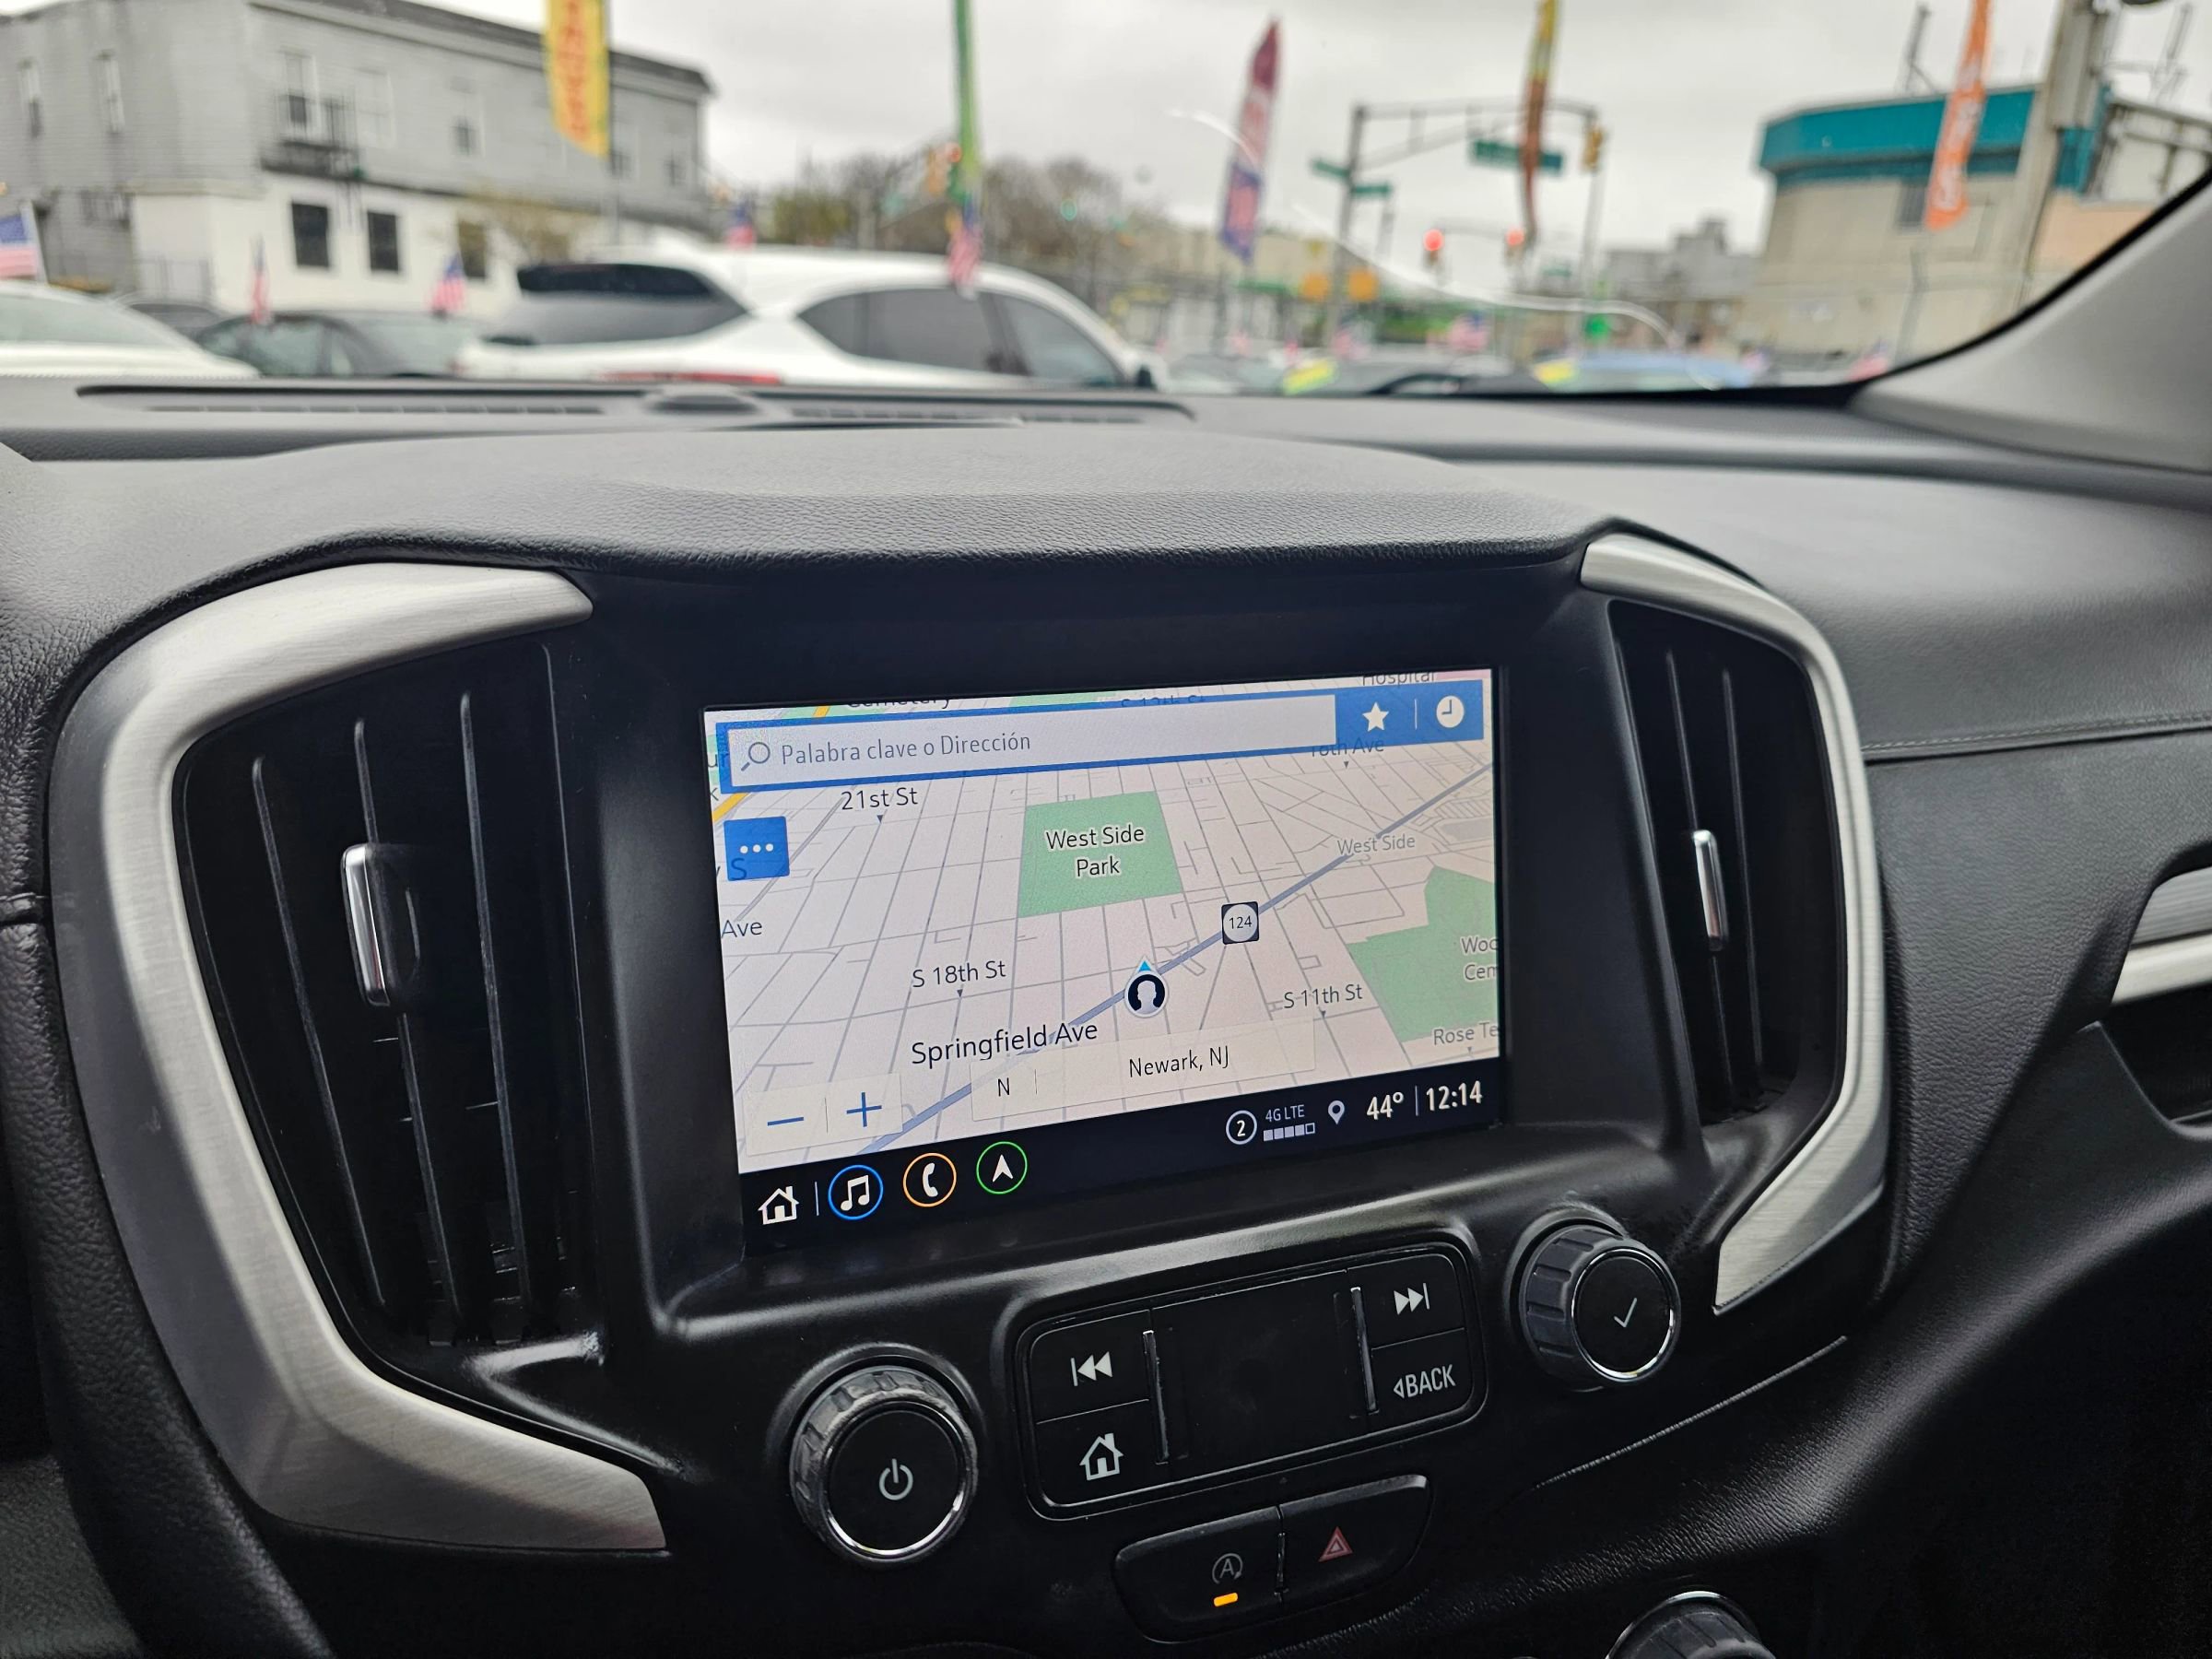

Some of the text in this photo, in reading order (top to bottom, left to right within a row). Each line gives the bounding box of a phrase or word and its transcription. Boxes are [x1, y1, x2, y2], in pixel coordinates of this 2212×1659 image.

[782, 732, 1031, 765] Palabra clave o Dirección
[1352, 737, 1385, 754] Ave
[841, 786, 919, 811] 21st St
[1045, 823, 1145, 850] West Side
[1336, 831, 1416, 855] West Side
[1077, 854, 1121, 877] Park
[721, 919, 763, 939] Ave
[1229, 915, 1253, 931] 124
[912, 959, 1006, 987] S 18th St
[1284, 982, 1363, 1008] S 11th St
[911, 1021, 1099, 1069] Springfield Ave
[1433, 1028, 1475, 1045] Rose
[1128, 1045, 1230, 1077] Newark, NJ
[996, 1077, 1010, 1097] N
[1426, 1080, 1483, 1112] 12:14
[1265, 1104, 1305, 1123] 4G LTE
[1366, 1091, 1405, 1121] 44°
[1236, 1120, 1246, 1137] 2
[1406, 1364, 1456, 1398] BACK
